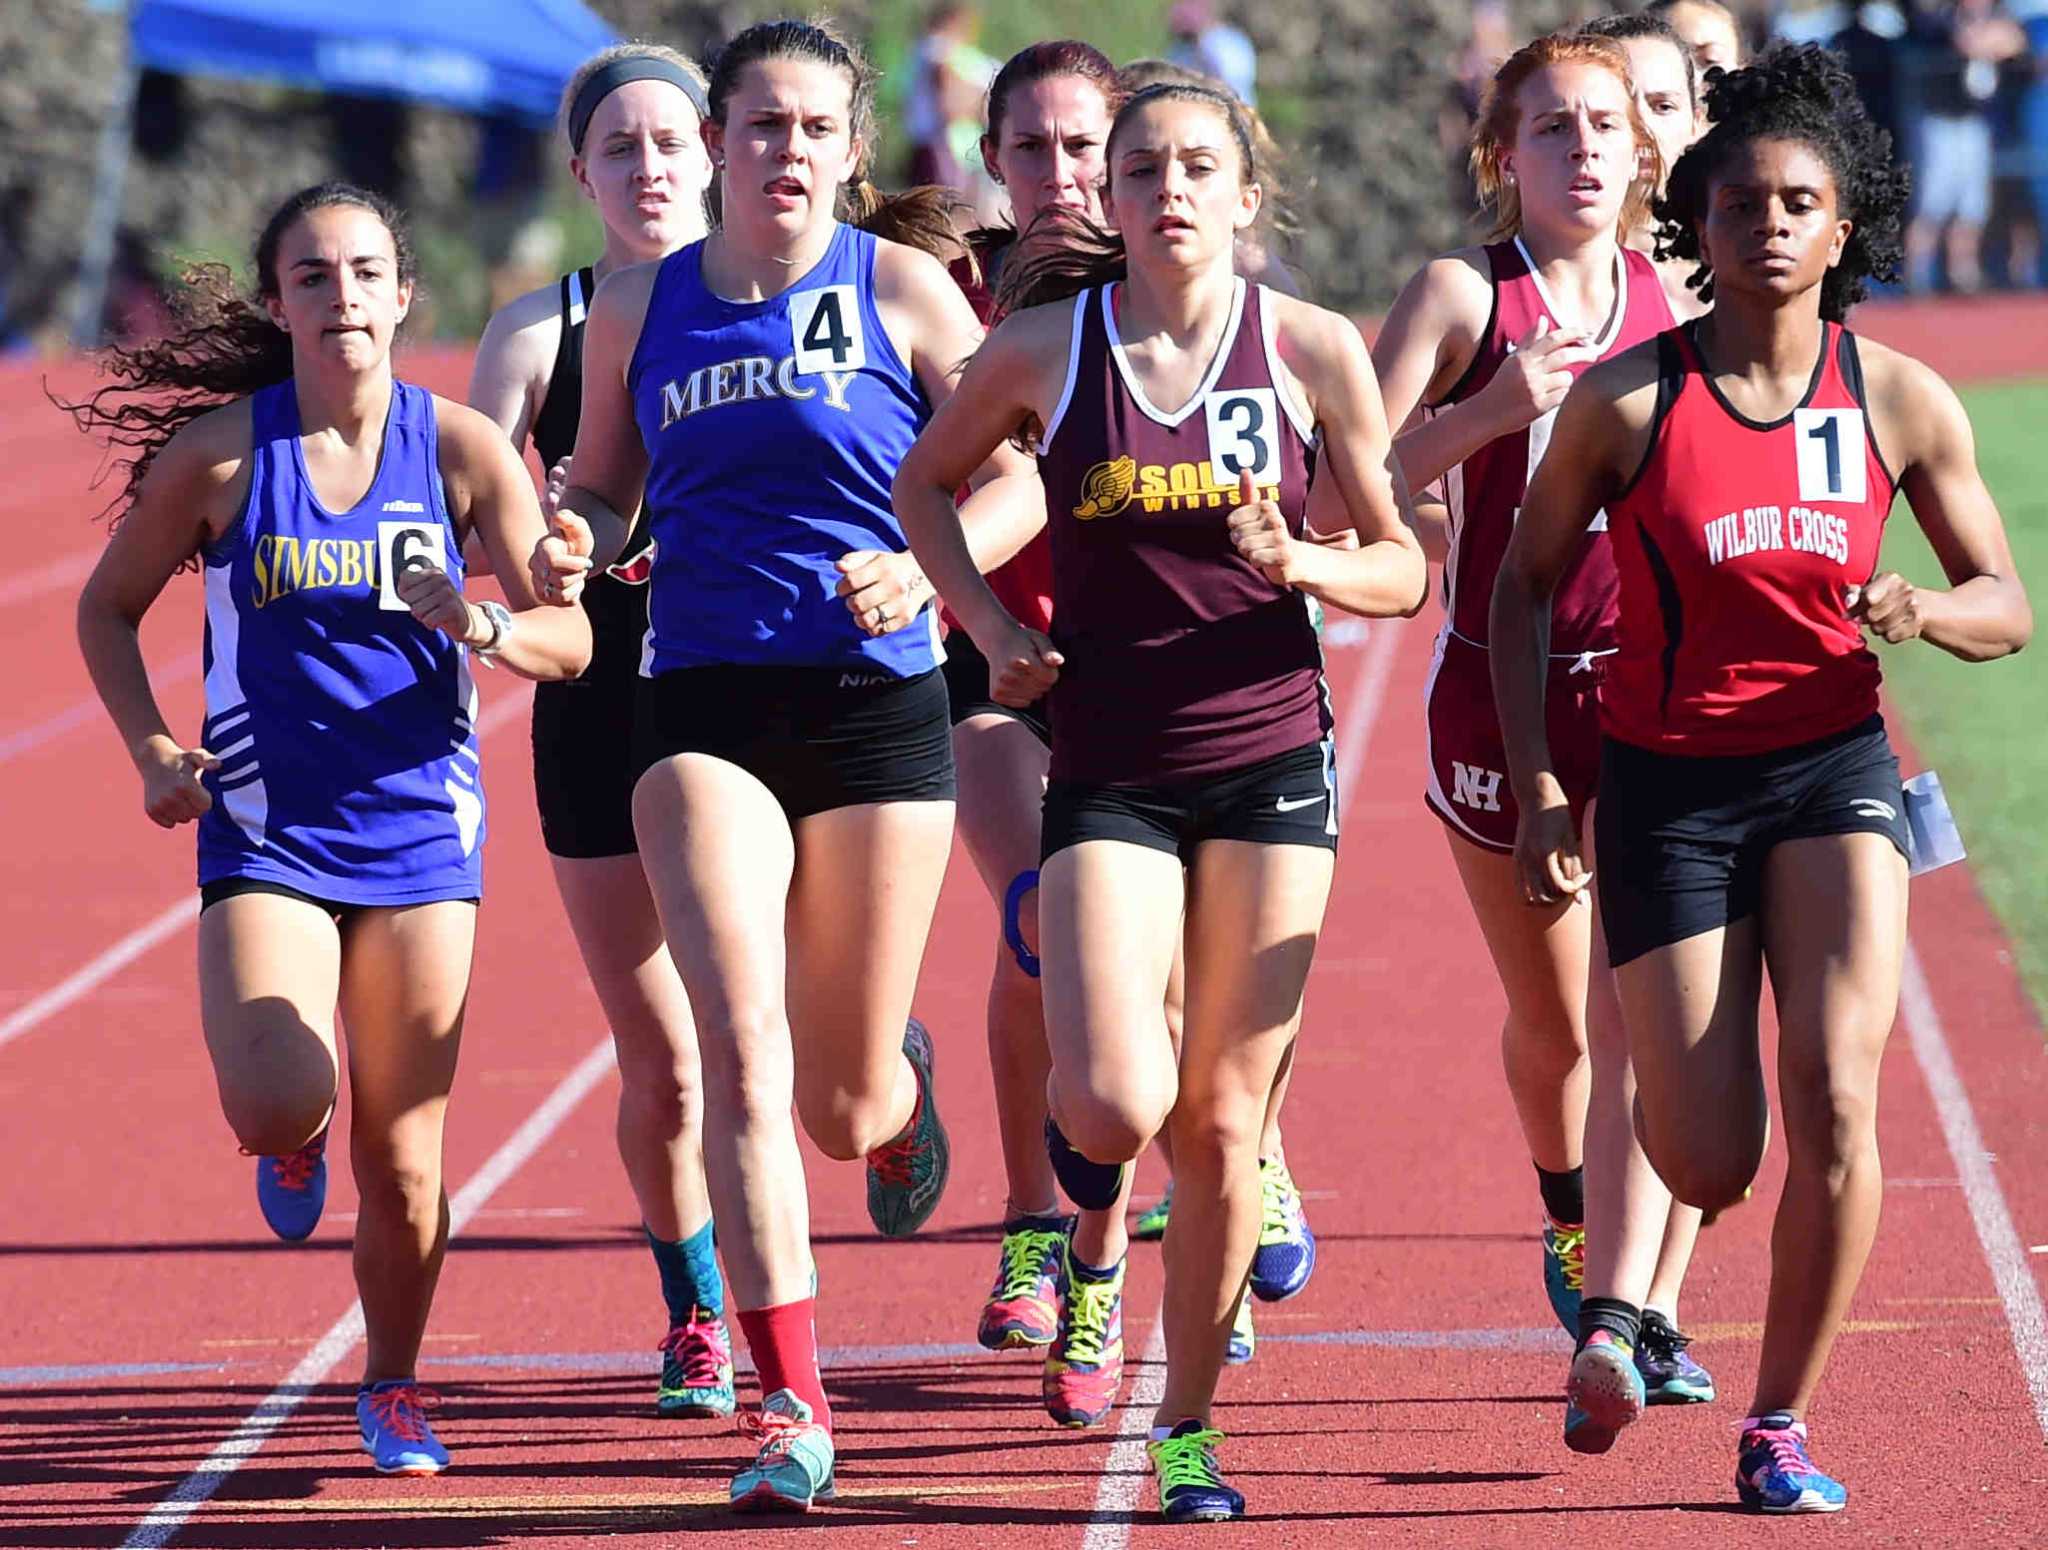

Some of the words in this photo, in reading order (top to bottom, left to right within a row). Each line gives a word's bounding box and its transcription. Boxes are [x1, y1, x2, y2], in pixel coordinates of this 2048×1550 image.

[803, 291, 853, 364] 4
[659, 355, 858, 432] MERCY
[1219, 397, 1268, 476] 3
[1808, 416, 1842, 493] 1
[251, 533, 381, 609] SIMSBU
[391, 528, 434, 601] 6
[1703, 505, 1784, 565] WILBUR
[1788, 505, 1849, 565] CROSS
[1451, 760, 1504, 812] NH
